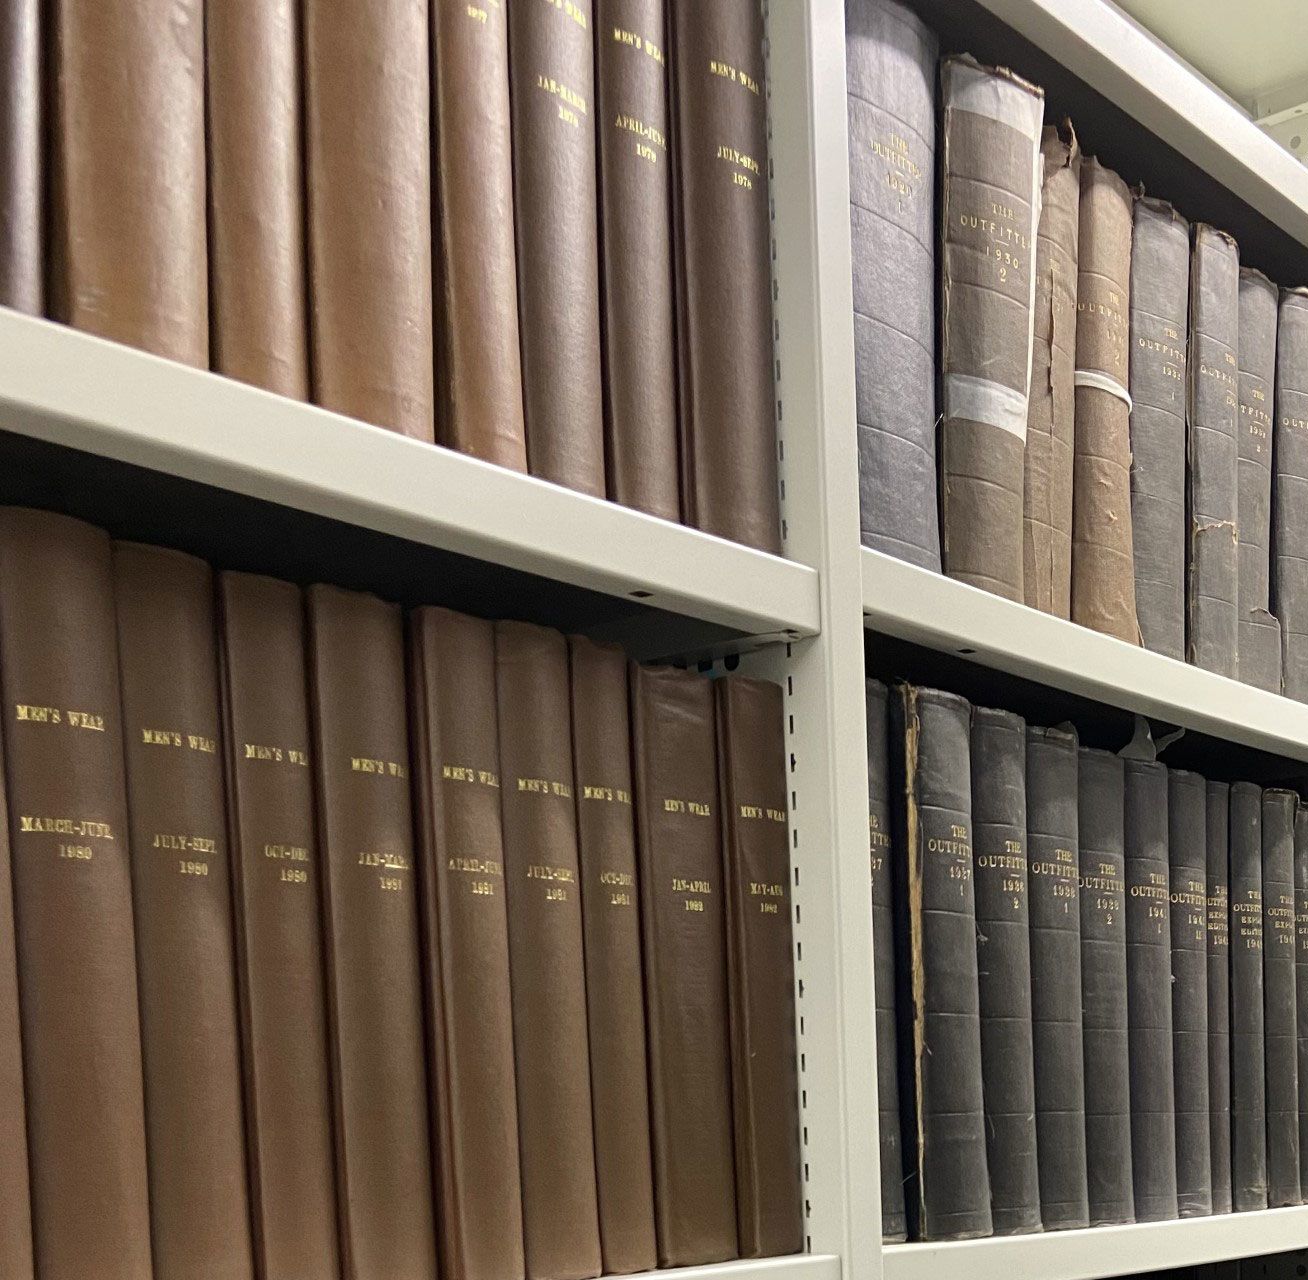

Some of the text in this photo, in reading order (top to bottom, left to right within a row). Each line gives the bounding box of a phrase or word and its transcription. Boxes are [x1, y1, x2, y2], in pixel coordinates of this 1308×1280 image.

[614, 28, 642, 50] MEN'S
[710, 61, 736, 82] MEN'S
[615, 113, 667, 150] APRIL-JUN
[991, 203, 1015, 221] THE
[987, 246, 1019, 270] 1930
[999, 267, 1007, 283] 2
[1164, 327, 1178, 340] THE
[1139, 338, 1186, 364] OUTFITT
[16, 705, 105, 731] MEN'S WEAR
[142, 729, 182, 747] MEN'S
[245, 744, 309, 766] MEN'S WE
[351, 758, 384, 774] MEN'S
[443, 766, 474, 782] MEN'S
[518, 778, 549, 793] MEN'S
[584, 786, 613, 801] MEN'S
[664, 799, 711, 817] MEN'S WEAR
[741, 806, 786, 822] MEN'S WEAR
[20, 816, 114, 840] MARCH-JUNE
[951, 825, 967, 840] THE
[60, 845, 93, 860] 1980
[265, 845, 310, 862] OCT-DE
[1005, 840, 1022, 855] THE
[978, 855, 1028, 872] OUTFITT
[1056, 849, 1072, 863] THE
[179, 861, 208, 876] 1980
[449, 859, 502, 876] APRIL-JUN
[1032, 861, 1079, 877] OUTFITT
[1099, 863, 1116, 876] THE
[280, 869, 307, 883] 1980
[1149, 873, 1166, 886] THE
[672, 878, 712, 894] JAN-APRIL
[1130, 886, 1169, 900] OUTFITT
[1188, 881, 1204, 893] THE
[1170, 893, 1206, 906] OUTFIT
[1106, 913, 1113, 925] 2
